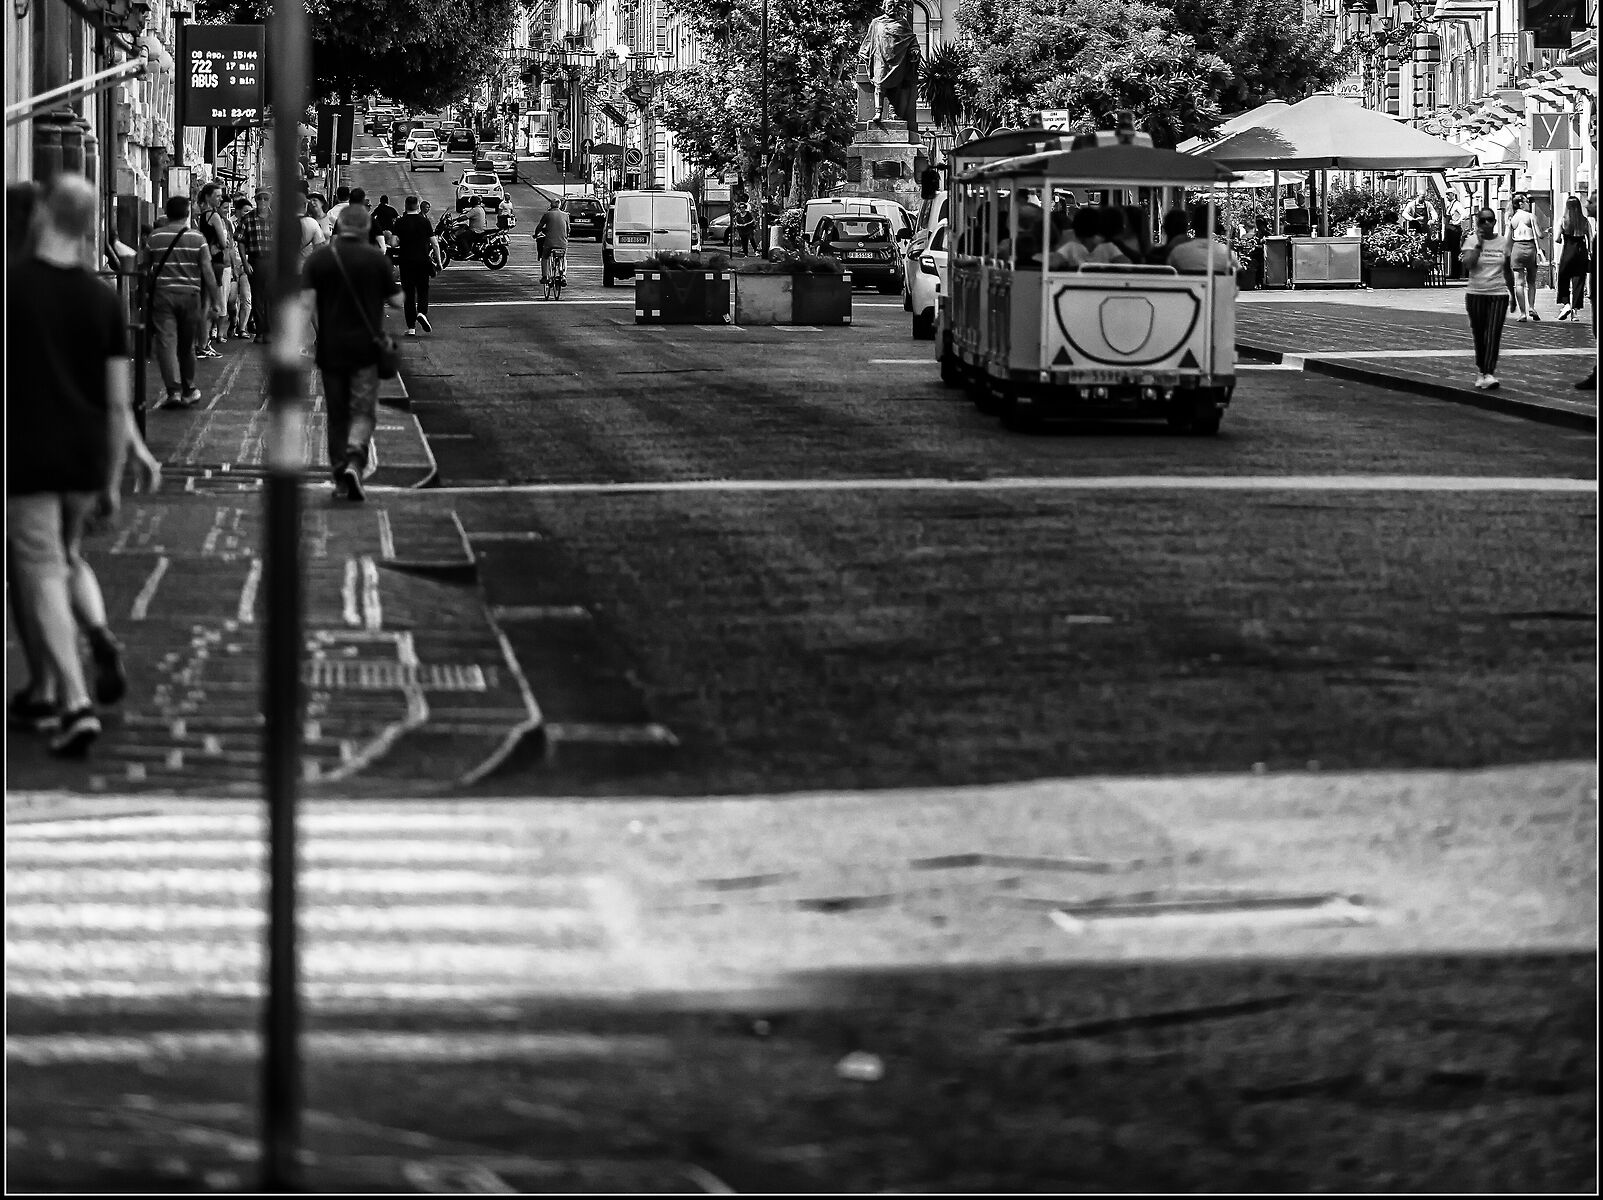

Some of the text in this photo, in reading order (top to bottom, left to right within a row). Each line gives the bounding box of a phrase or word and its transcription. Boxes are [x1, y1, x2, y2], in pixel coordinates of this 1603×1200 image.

[191, 59, 256, 74] 722 17 min
[191, 73, 256, 89] ABUS 3 min
